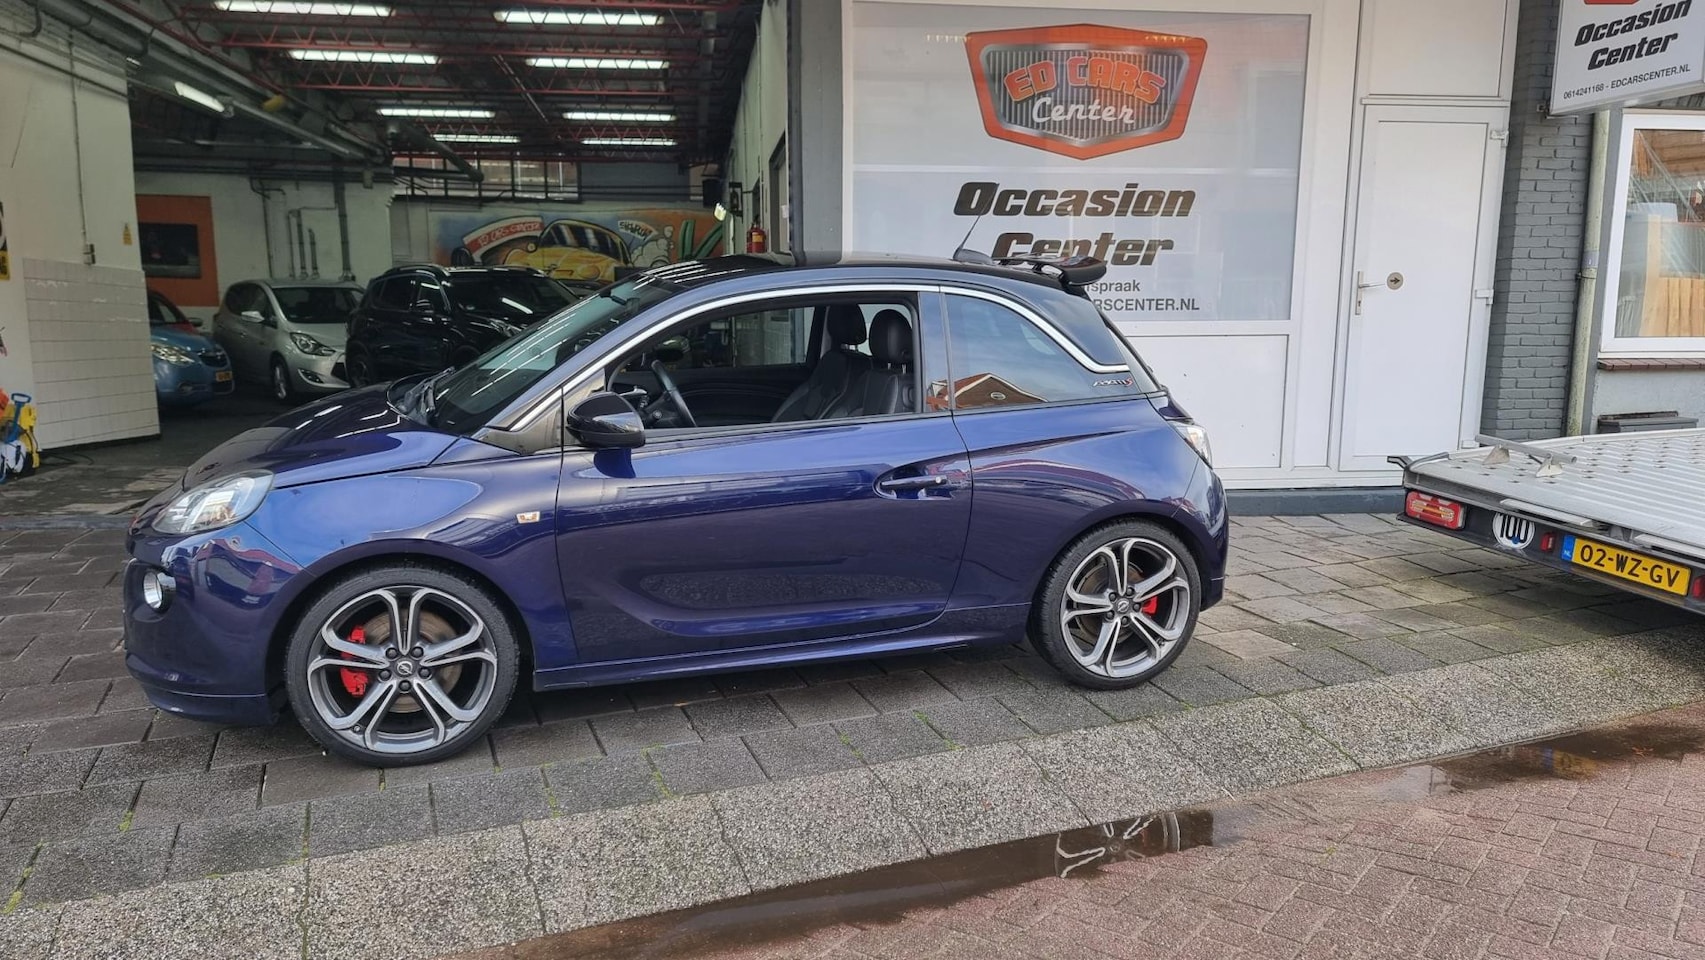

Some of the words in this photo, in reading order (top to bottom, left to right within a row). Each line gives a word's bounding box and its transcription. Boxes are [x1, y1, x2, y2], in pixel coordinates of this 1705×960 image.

[1574, 0, 1693, 47] Occasion
[1587, 32, 1679, 71] Center
[1003, 60, 1057, 102] ED
[1066, 55, 1166, 105] CARS
[1611, 64, 1691, 89] EDCARSCENTER.NL
[1032, 97, 1135, 124] Center
[953, 181, 1196, 217] Occasion
[1579, 543, 1681, 588] 02-WZ-GV
